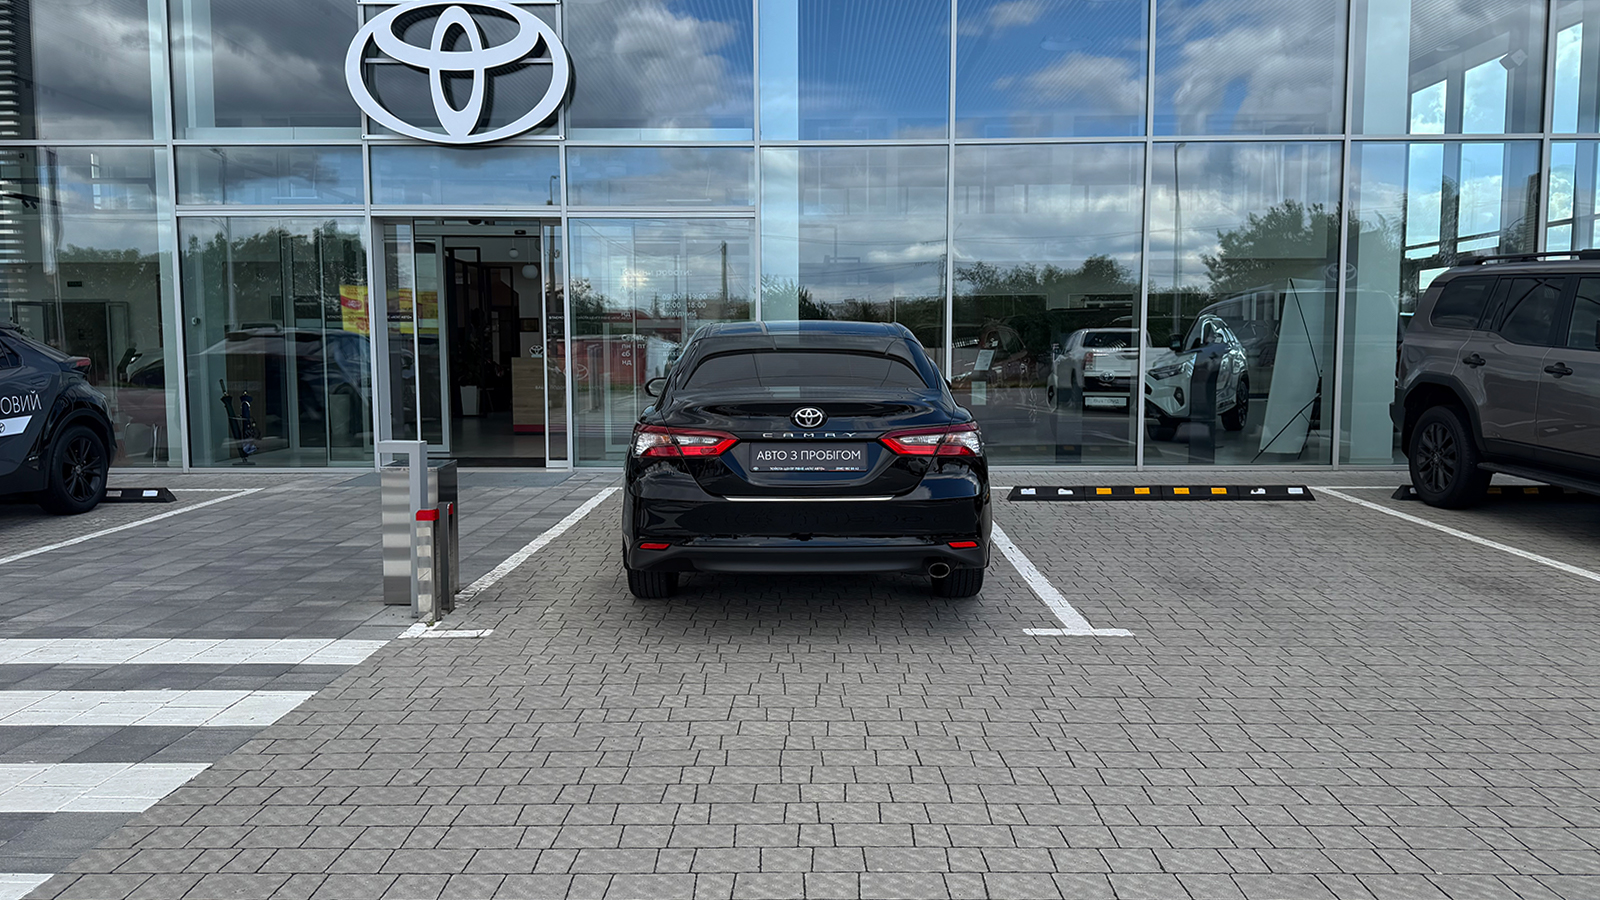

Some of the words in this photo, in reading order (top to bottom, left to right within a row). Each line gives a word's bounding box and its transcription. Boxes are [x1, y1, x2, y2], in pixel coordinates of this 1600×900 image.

[656, 268, 693, 277] роботи:
[756, 450, 788, 460] АВТО
[800, 450, 861, 460] ПРОБІГОМ
